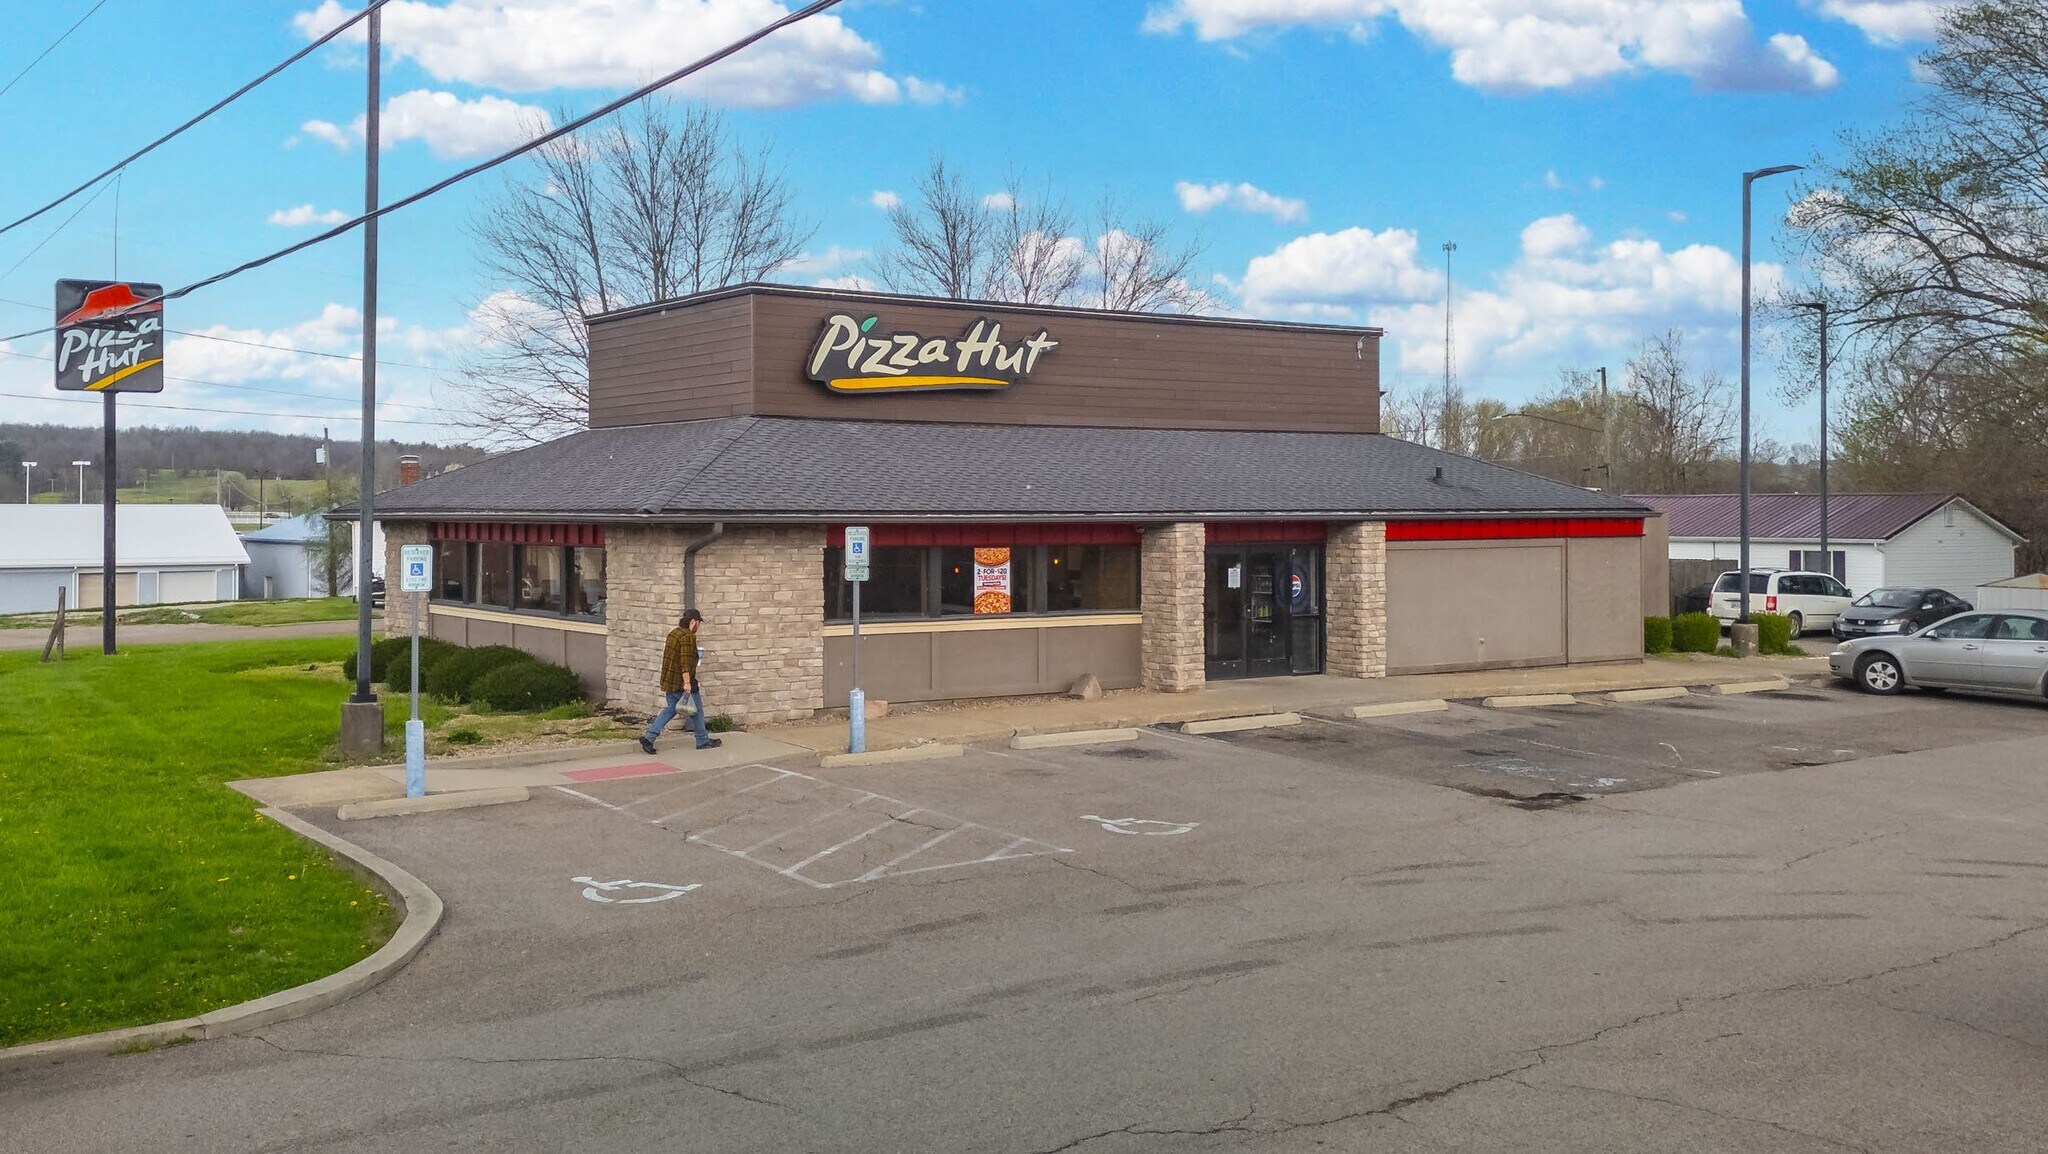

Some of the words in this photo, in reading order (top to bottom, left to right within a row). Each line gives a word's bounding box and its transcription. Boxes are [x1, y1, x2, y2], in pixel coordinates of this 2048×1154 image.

[58, 317, 162, 373] Pizza
[78, 339, 154, 383] Hut
[811, 314, 950, 376] Pizza
[956, 320, 1059, 374] Hut
